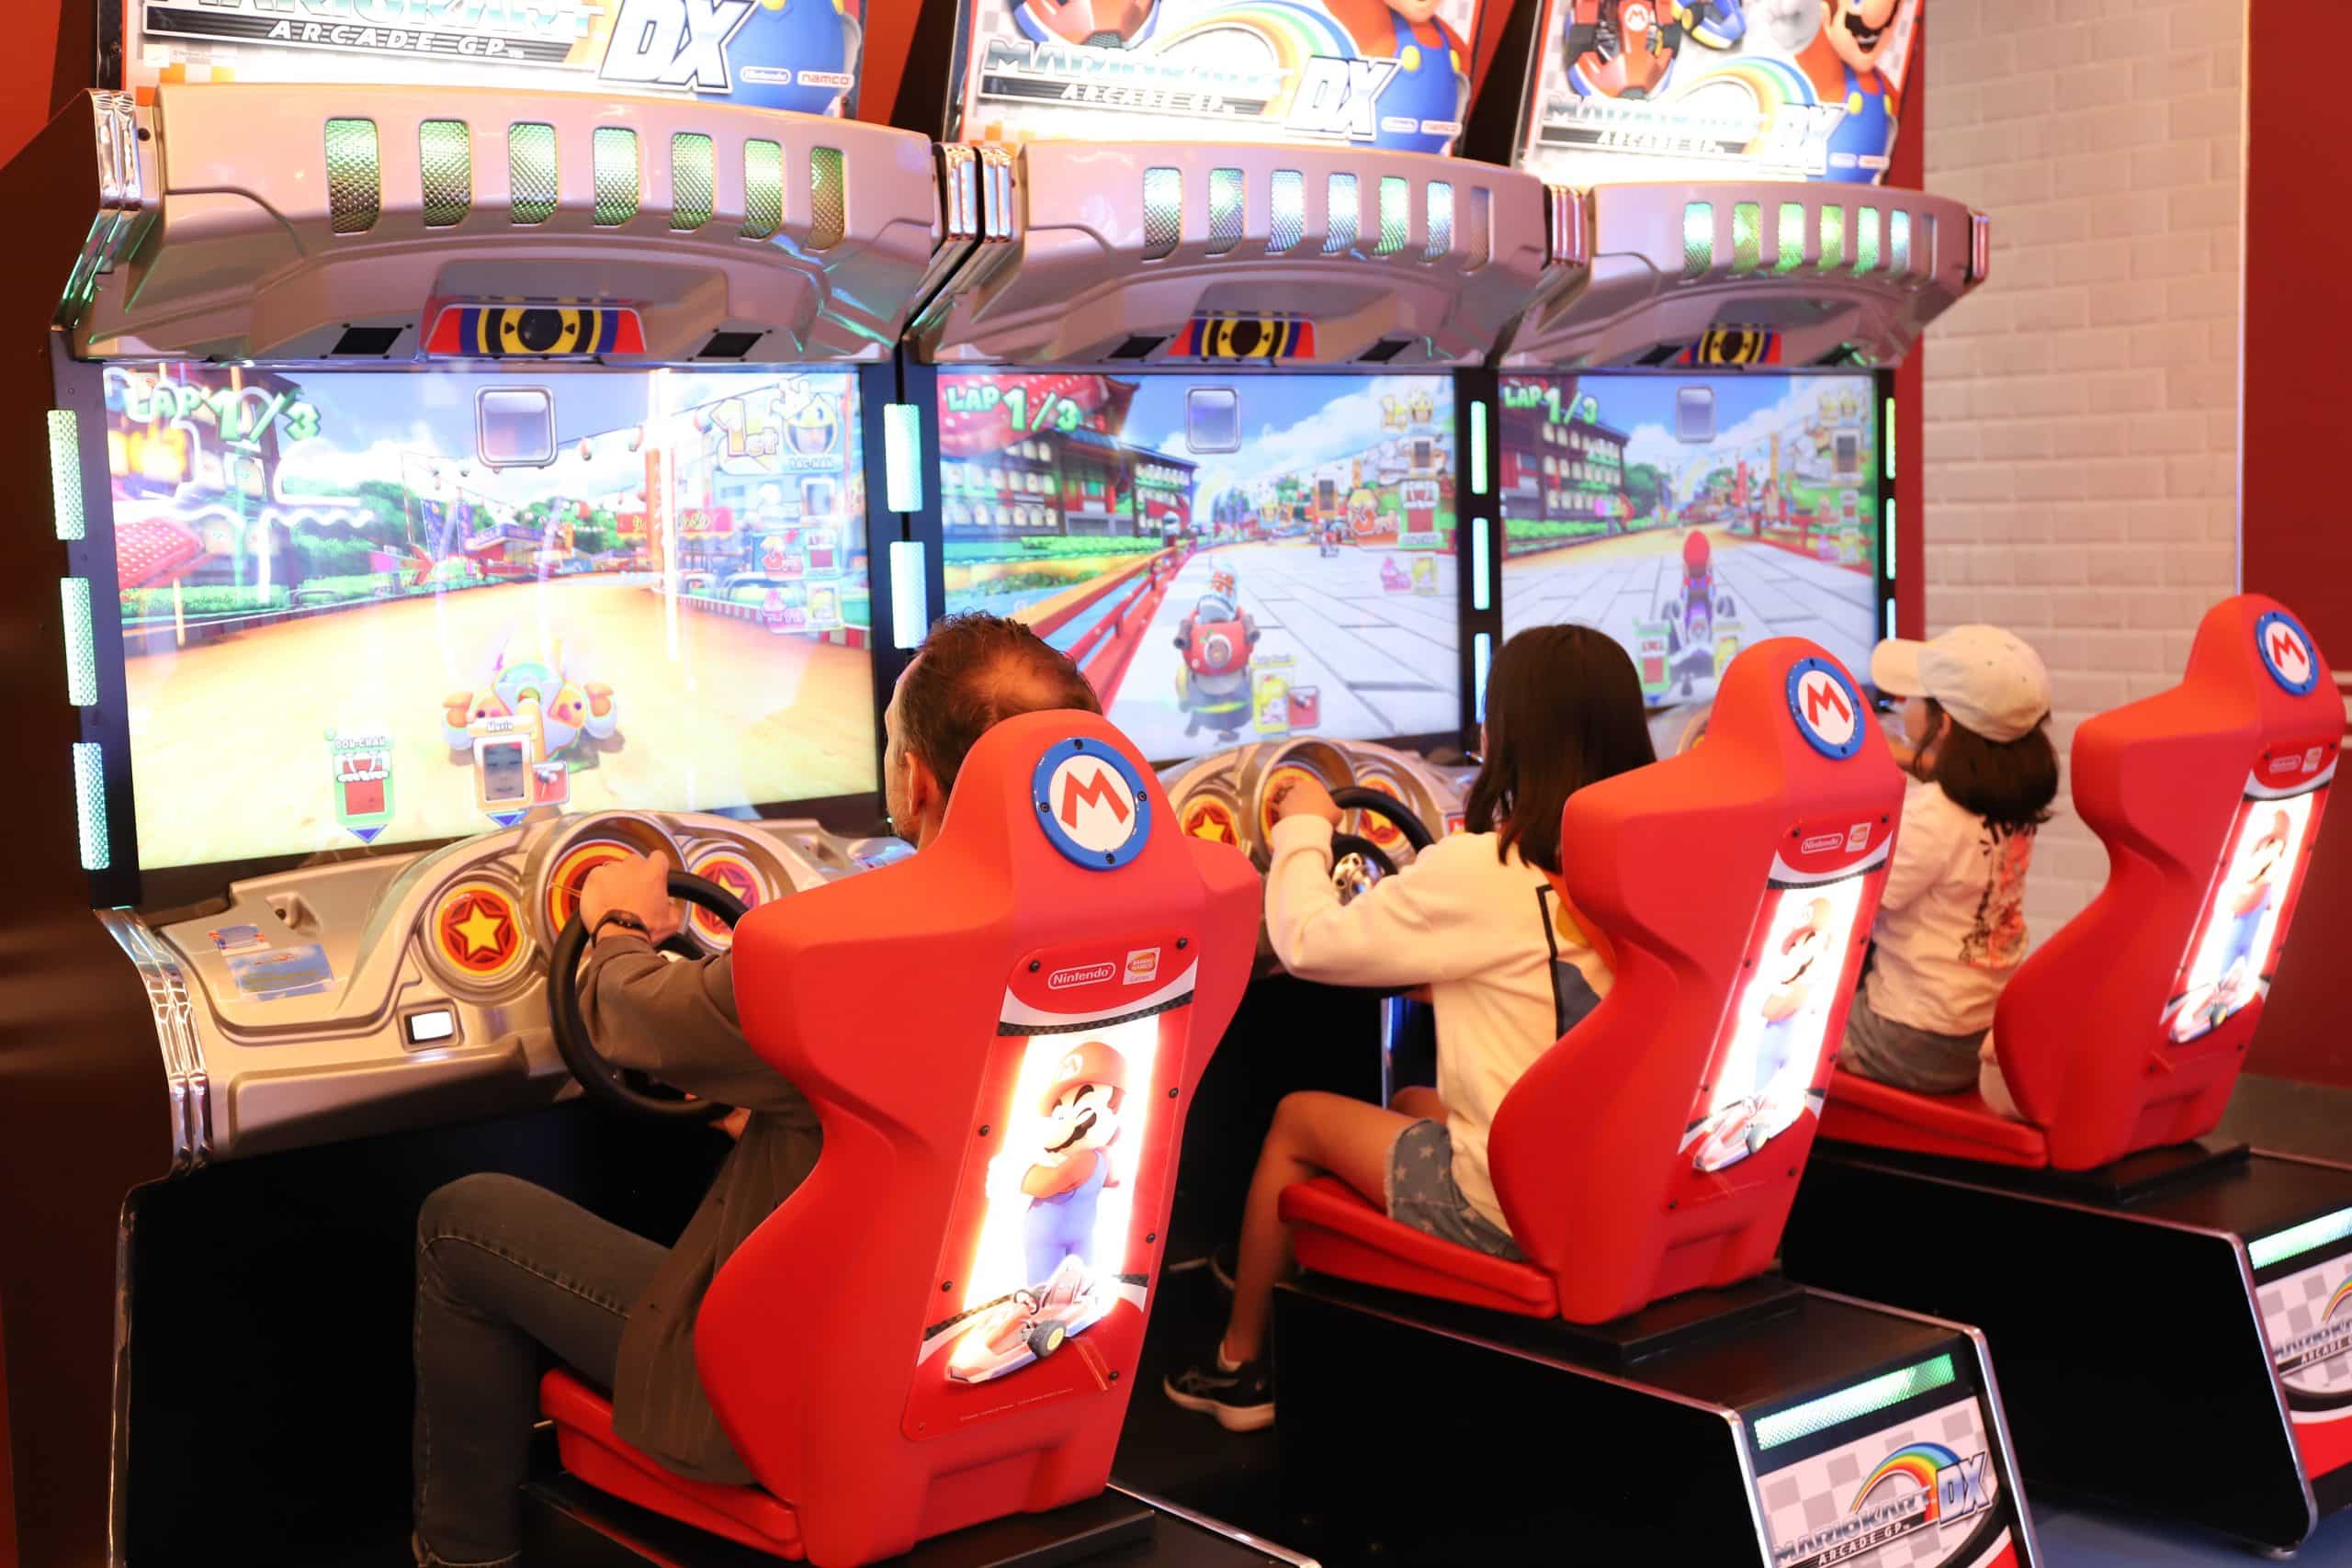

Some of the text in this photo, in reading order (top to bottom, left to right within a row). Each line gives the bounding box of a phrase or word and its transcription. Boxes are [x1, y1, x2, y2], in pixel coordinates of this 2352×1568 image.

[145, 0, 755, 90] OKART DX
[268, 19, 505, 56] ARCADE GP
[801, 73, 849, 85] namco
[1286, 55, 1398, 138] DX
[124, 384, 321, 442] LAP 1/3
[945, 384, 1080, 433] LAP 1/3
[1504, 384, 1598, 424] LAP 1/3
[2272, 631, 2306, 669] M
[1806, 681, 1850, 727] M
[1060, 768, 1130, 830] M
[1051, 965, 1112, 987] Nintendo
[1773, 1450, 1992, 1563] MARIOKART DX
[1818, 1522, 1905, 1566] ARCADE GP
